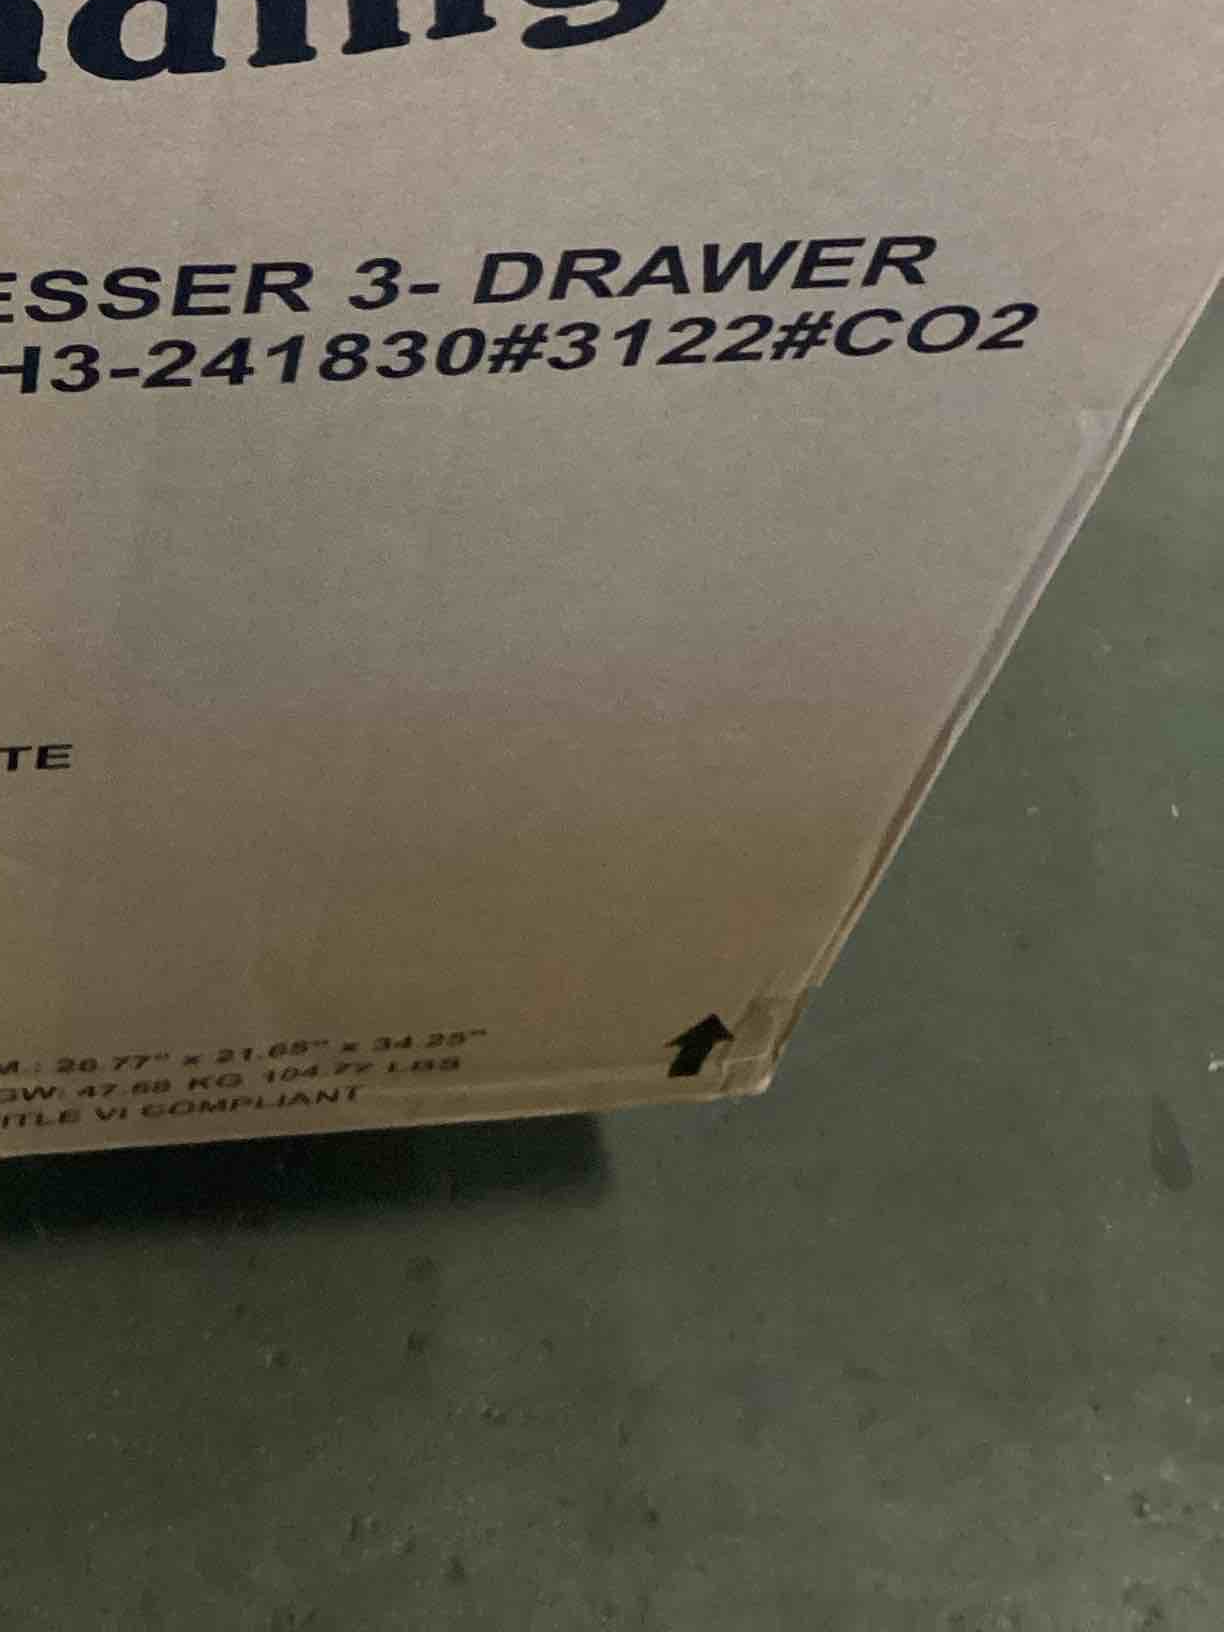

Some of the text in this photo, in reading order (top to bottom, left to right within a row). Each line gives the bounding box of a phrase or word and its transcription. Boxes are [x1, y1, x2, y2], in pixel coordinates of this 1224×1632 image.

[348, 257, 440, 311] 3-
[473, 235, 938, 305] DRAWER
[188, 1072, 244, 1091] KG
[387, 1055, 461, 1074] LBS
[94, 1105, 130, 1123] VI
[140, 1085, 364, 1119] COMPLIANT
